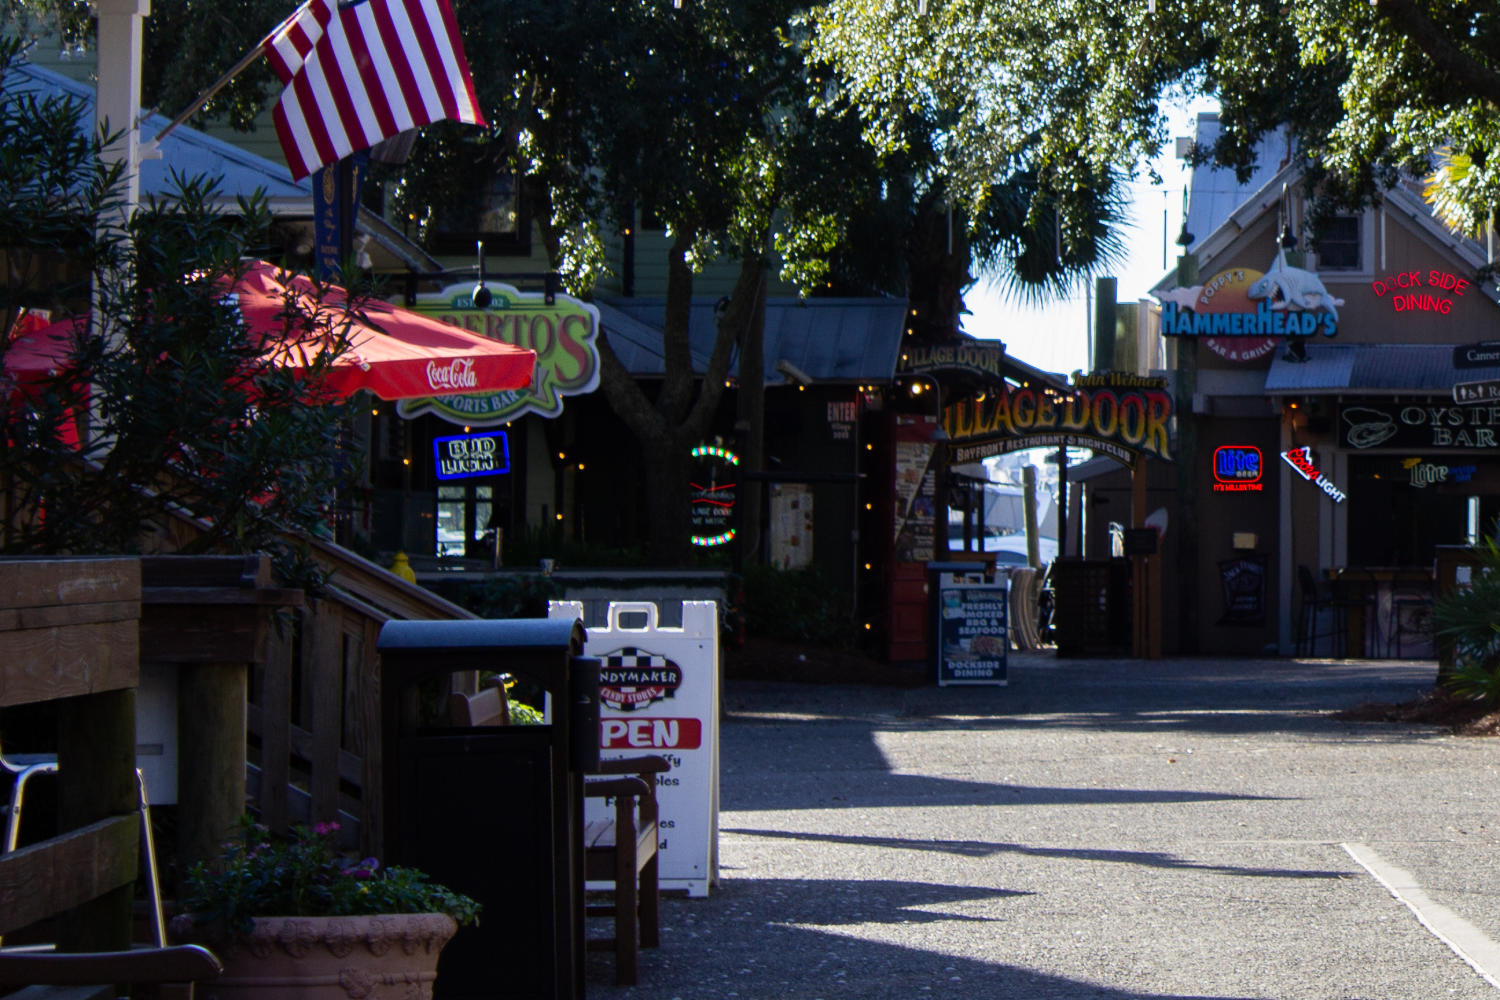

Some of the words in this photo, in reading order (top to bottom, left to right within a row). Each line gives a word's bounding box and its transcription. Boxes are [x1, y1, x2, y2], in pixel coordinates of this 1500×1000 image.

[1200, 270, 1245, 304] POPPY'S
[1372, 271, 1421, 297] DOCK
[1428, 270, 1470, 296] SIDE
[1393, 294, 1453, 314] DINING
[1207, 339, 1226, 358] BAR
[1229, 351, 1238, 360] &
[1241, 339, 1276, 360] GRILLE
[491, 390, 521, 411] BAR
[944, 386, 1057, 440] ILLAGE
[1063, 389, 1174, 461] DOOR
[1432, 427, 1499, 447] BAR
[957, 442, 1004, 461] BAYFRONT
[1007, 435, 1065, 451] RESTAURANT
[1078, 436, 1131, 462] NIGHTCLUB
[1315, 475, 1346, 503] LIGHT
[961, 602, 1004, 610] FRESHLY
[958, 627, 1005, 635] SEAFOOD
[947, 661, 999, 669] DOCKSIDE
[954, 669, 993, 677] DINING
[600, 671, 677, 683] NDYMAKER
[626, 686, 656, 702] STORES
[600, 719, 679, 747] PEN
